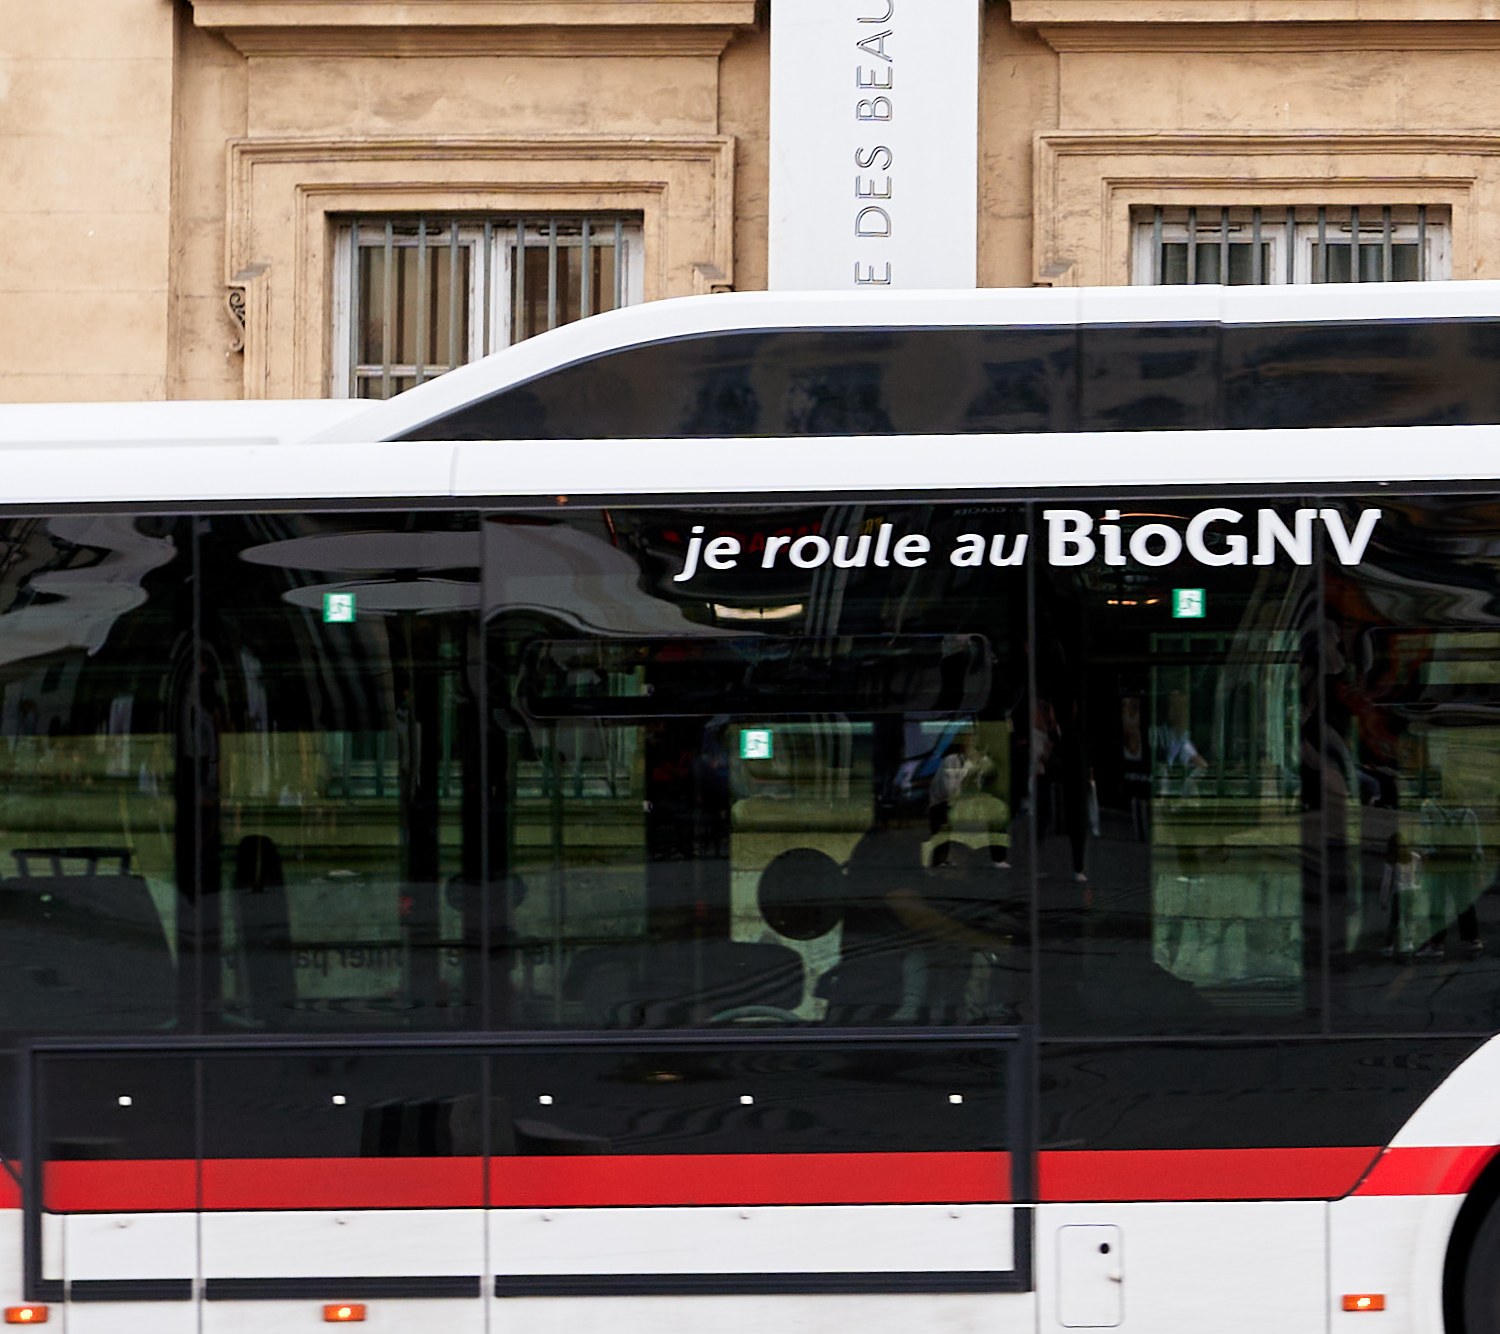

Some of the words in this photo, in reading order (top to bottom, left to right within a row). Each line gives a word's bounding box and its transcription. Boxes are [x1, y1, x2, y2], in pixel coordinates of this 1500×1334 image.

[854, 144, 894, 239] DES
[673, 525, 740, 582] je
[759, 522, 928, 568] roule
[949, 533, 1029, 567] au
[1042, 507, 1382, 567] BioGNV
